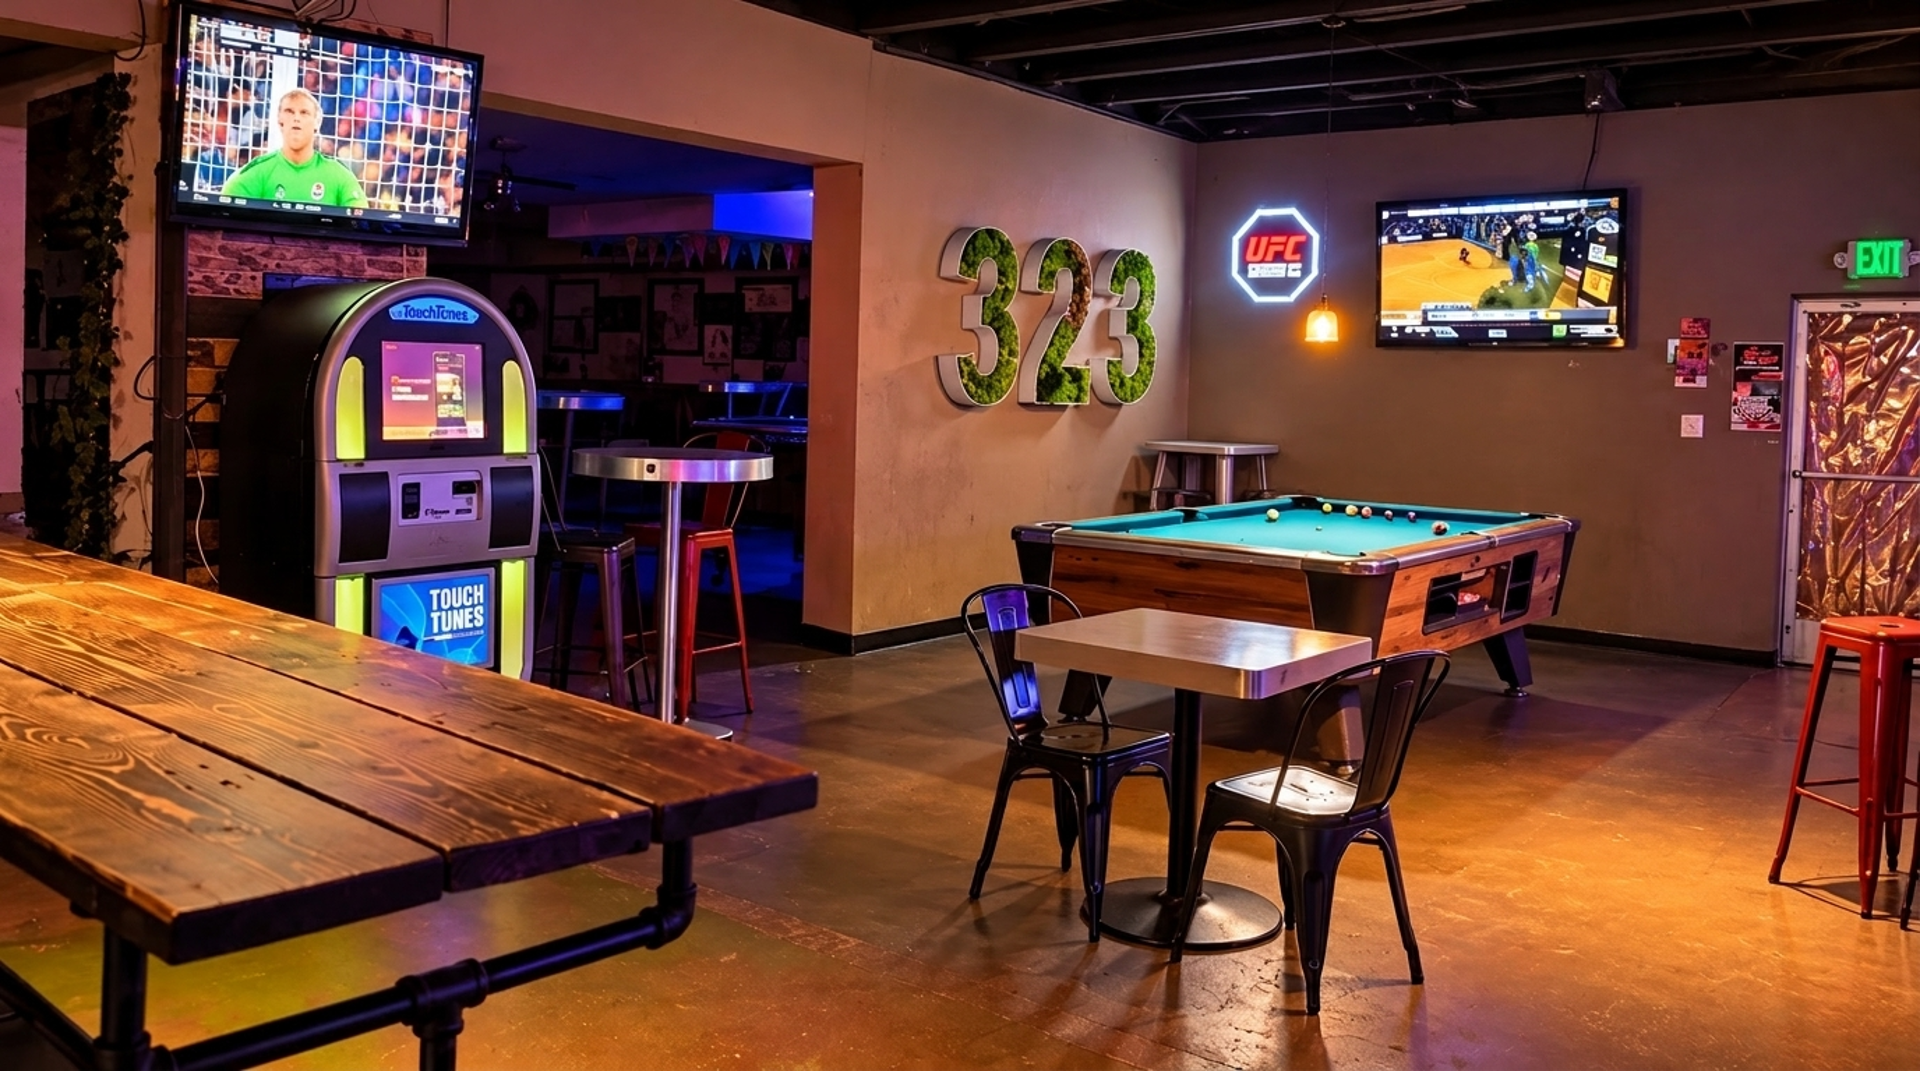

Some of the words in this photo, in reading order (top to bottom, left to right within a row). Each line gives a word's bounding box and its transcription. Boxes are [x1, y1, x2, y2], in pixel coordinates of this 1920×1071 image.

[1246, 235, 1307, 262] UFC
[1857, 240, 1903, 275] EXIT
[937, 226, 1157, 406] 323
[429, 584, 484, 611] TOUCH
[430, 605, 484, 634] TUNES
